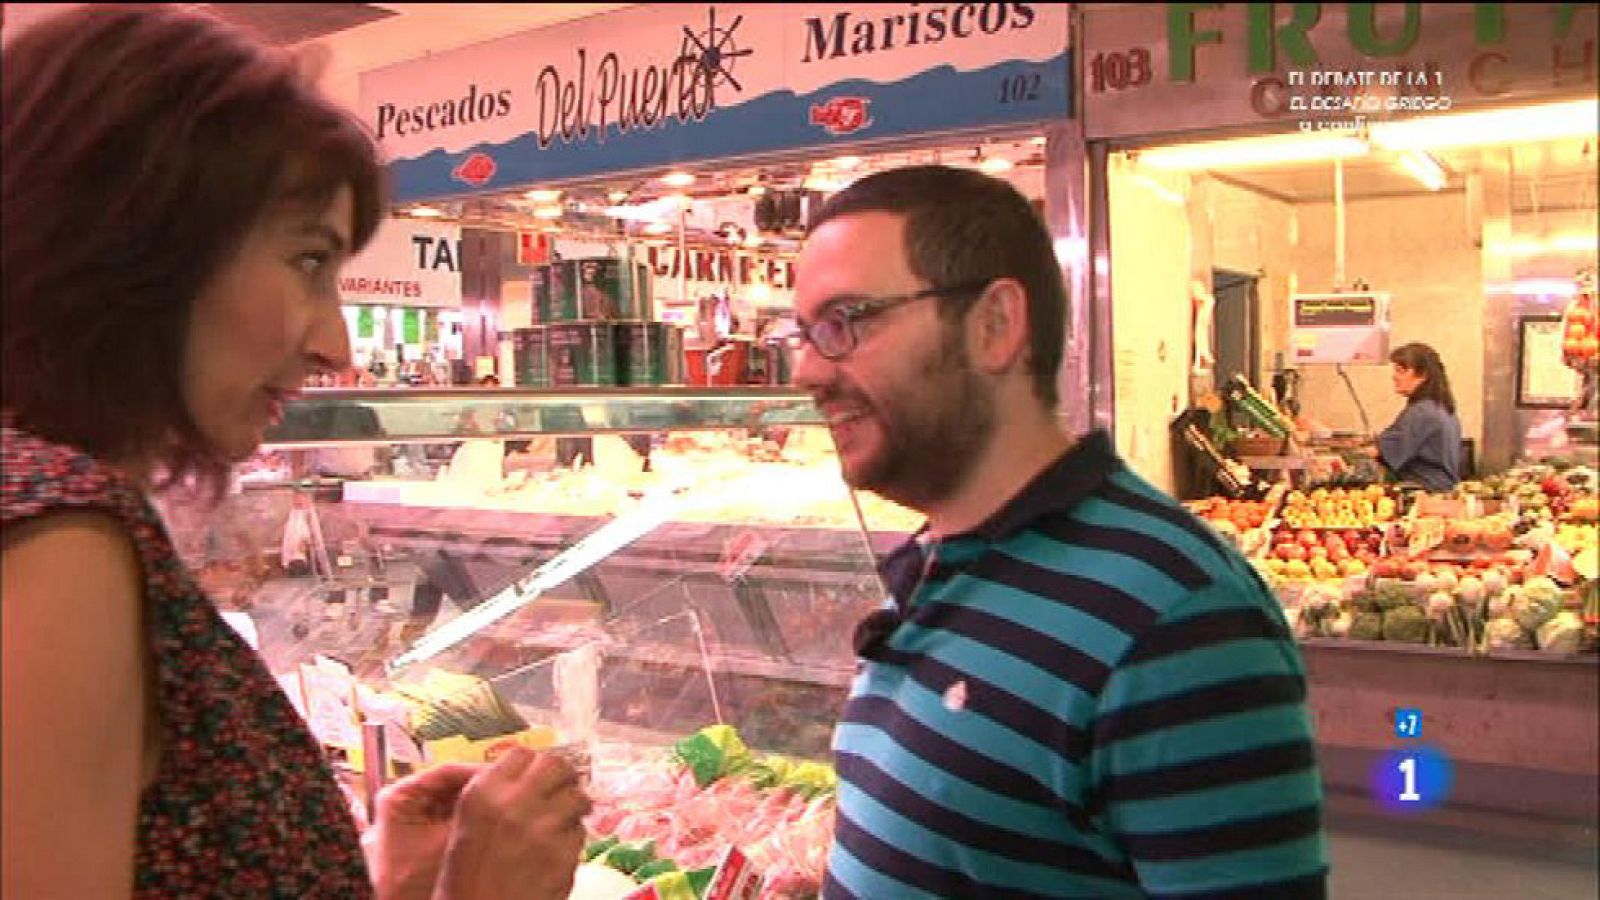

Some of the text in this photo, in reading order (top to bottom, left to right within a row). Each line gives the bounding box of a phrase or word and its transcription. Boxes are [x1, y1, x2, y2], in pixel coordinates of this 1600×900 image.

[375, 3, 1035, 147] Pescados Del Puerto Mariscos
[1091, 48, 1150, 92] 103
[999, 74, 1041, 104] 102
[339, 277, 421, 297] VARIANTES
